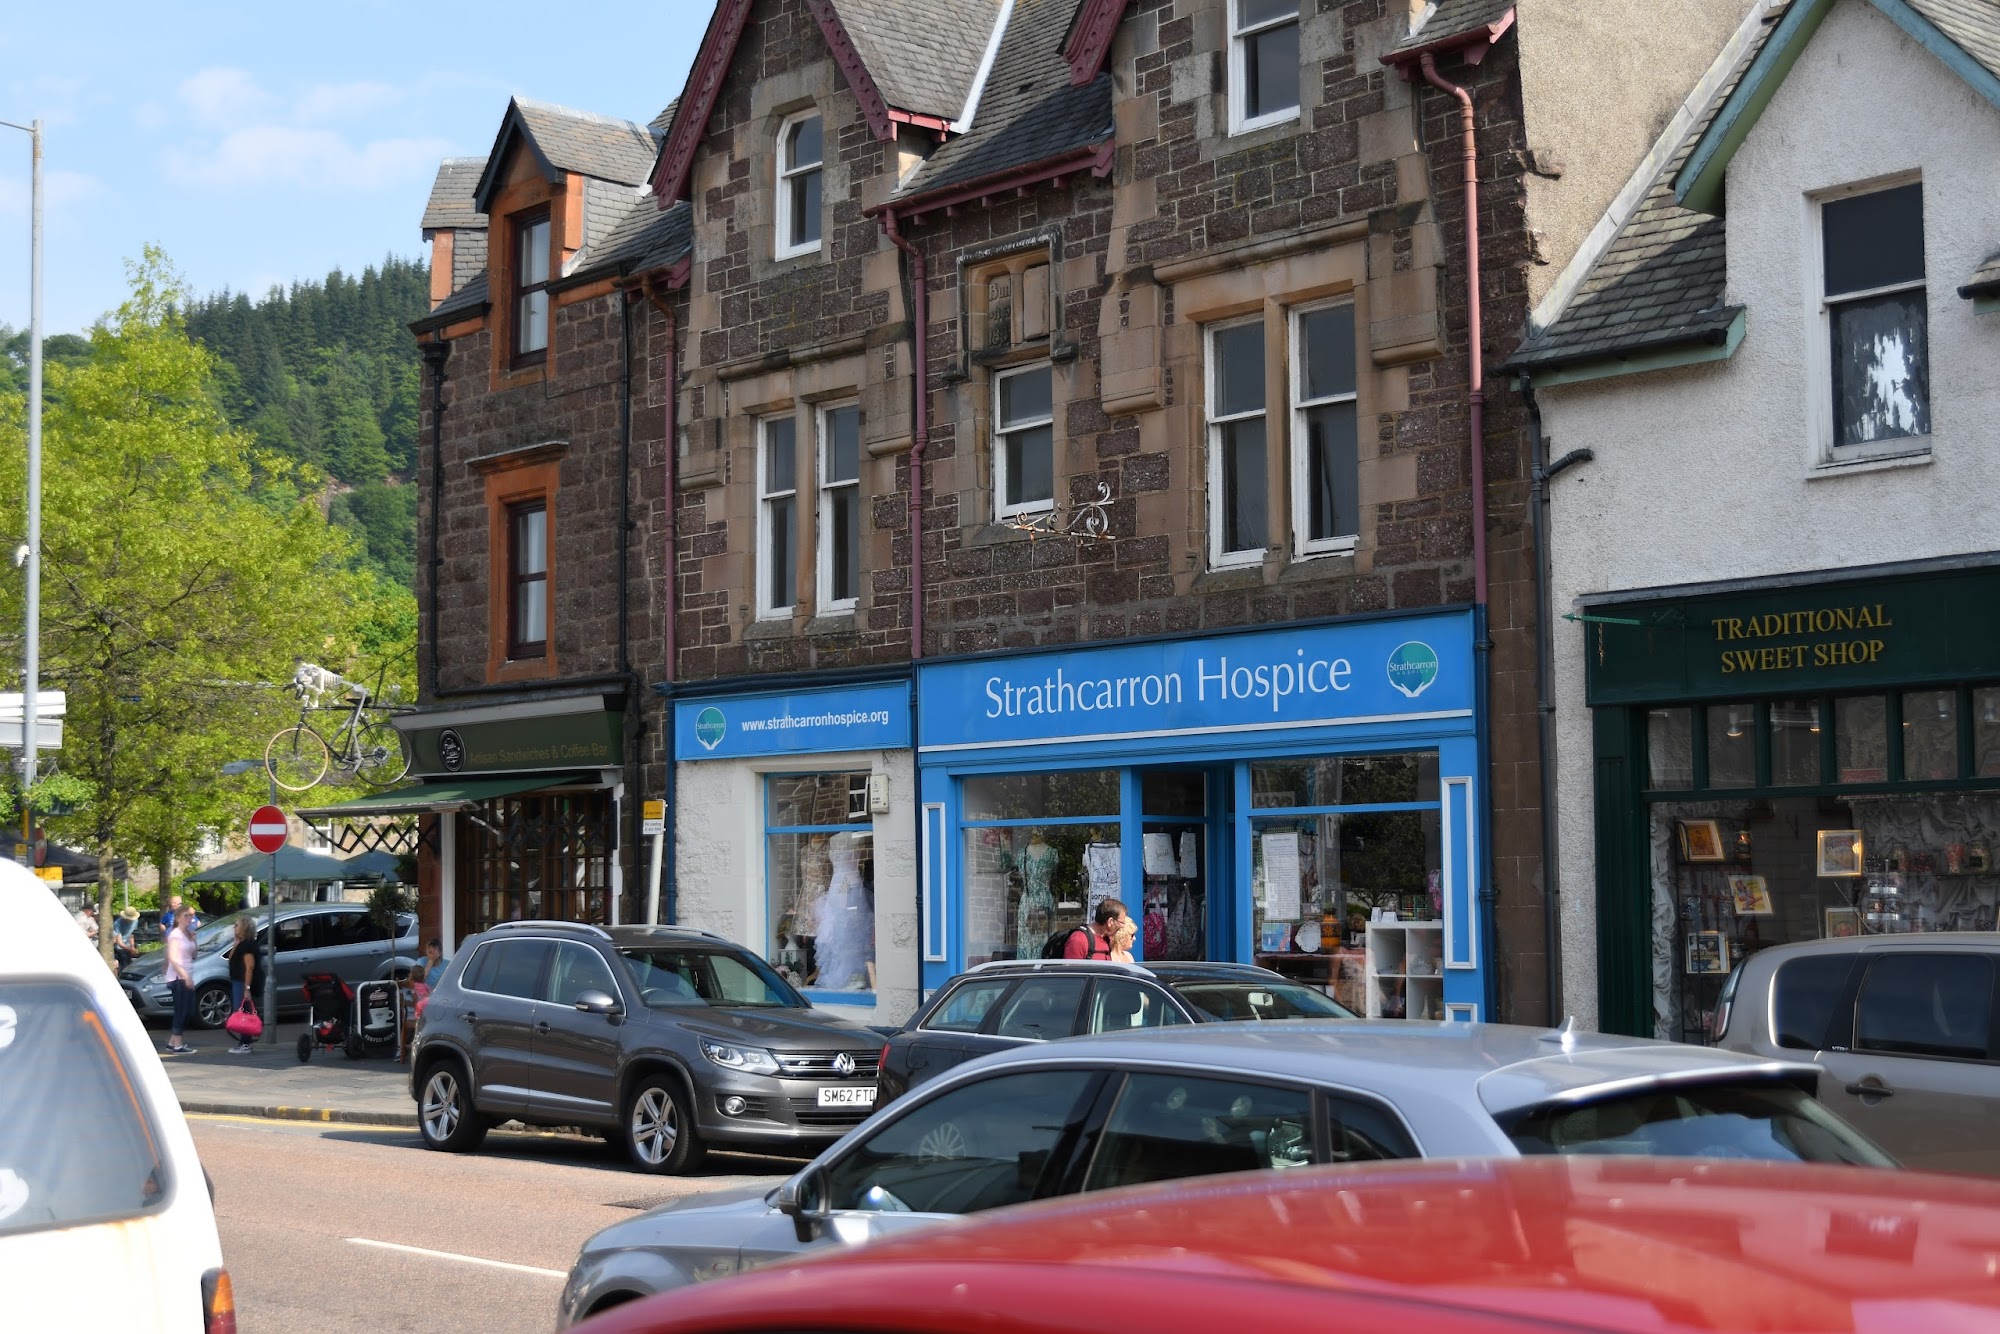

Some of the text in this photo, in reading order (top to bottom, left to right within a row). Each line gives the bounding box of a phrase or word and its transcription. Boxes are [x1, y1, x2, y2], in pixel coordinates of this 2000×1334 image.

[1711, 604, 1893, 641] TRADITIONAL
[1389, 661, 1436, 672] Strathcarron
[1721, 639, 1885, 673] SWEET SHOP
[985, 648, 1352, 718] Strathcarron Hospice
[742, 709, 889, 732] www.strathcarronhospice.org
[470, 751, 498, 765] Artisan
[499, 746, 550, 762] Sandwiches
[552, 745, 559, 759] &
[561, 743, 590, 758] Coffee
[591, 743, 608, 756] Bar
[824, 1089, 876, 1102] SM62 FTD
